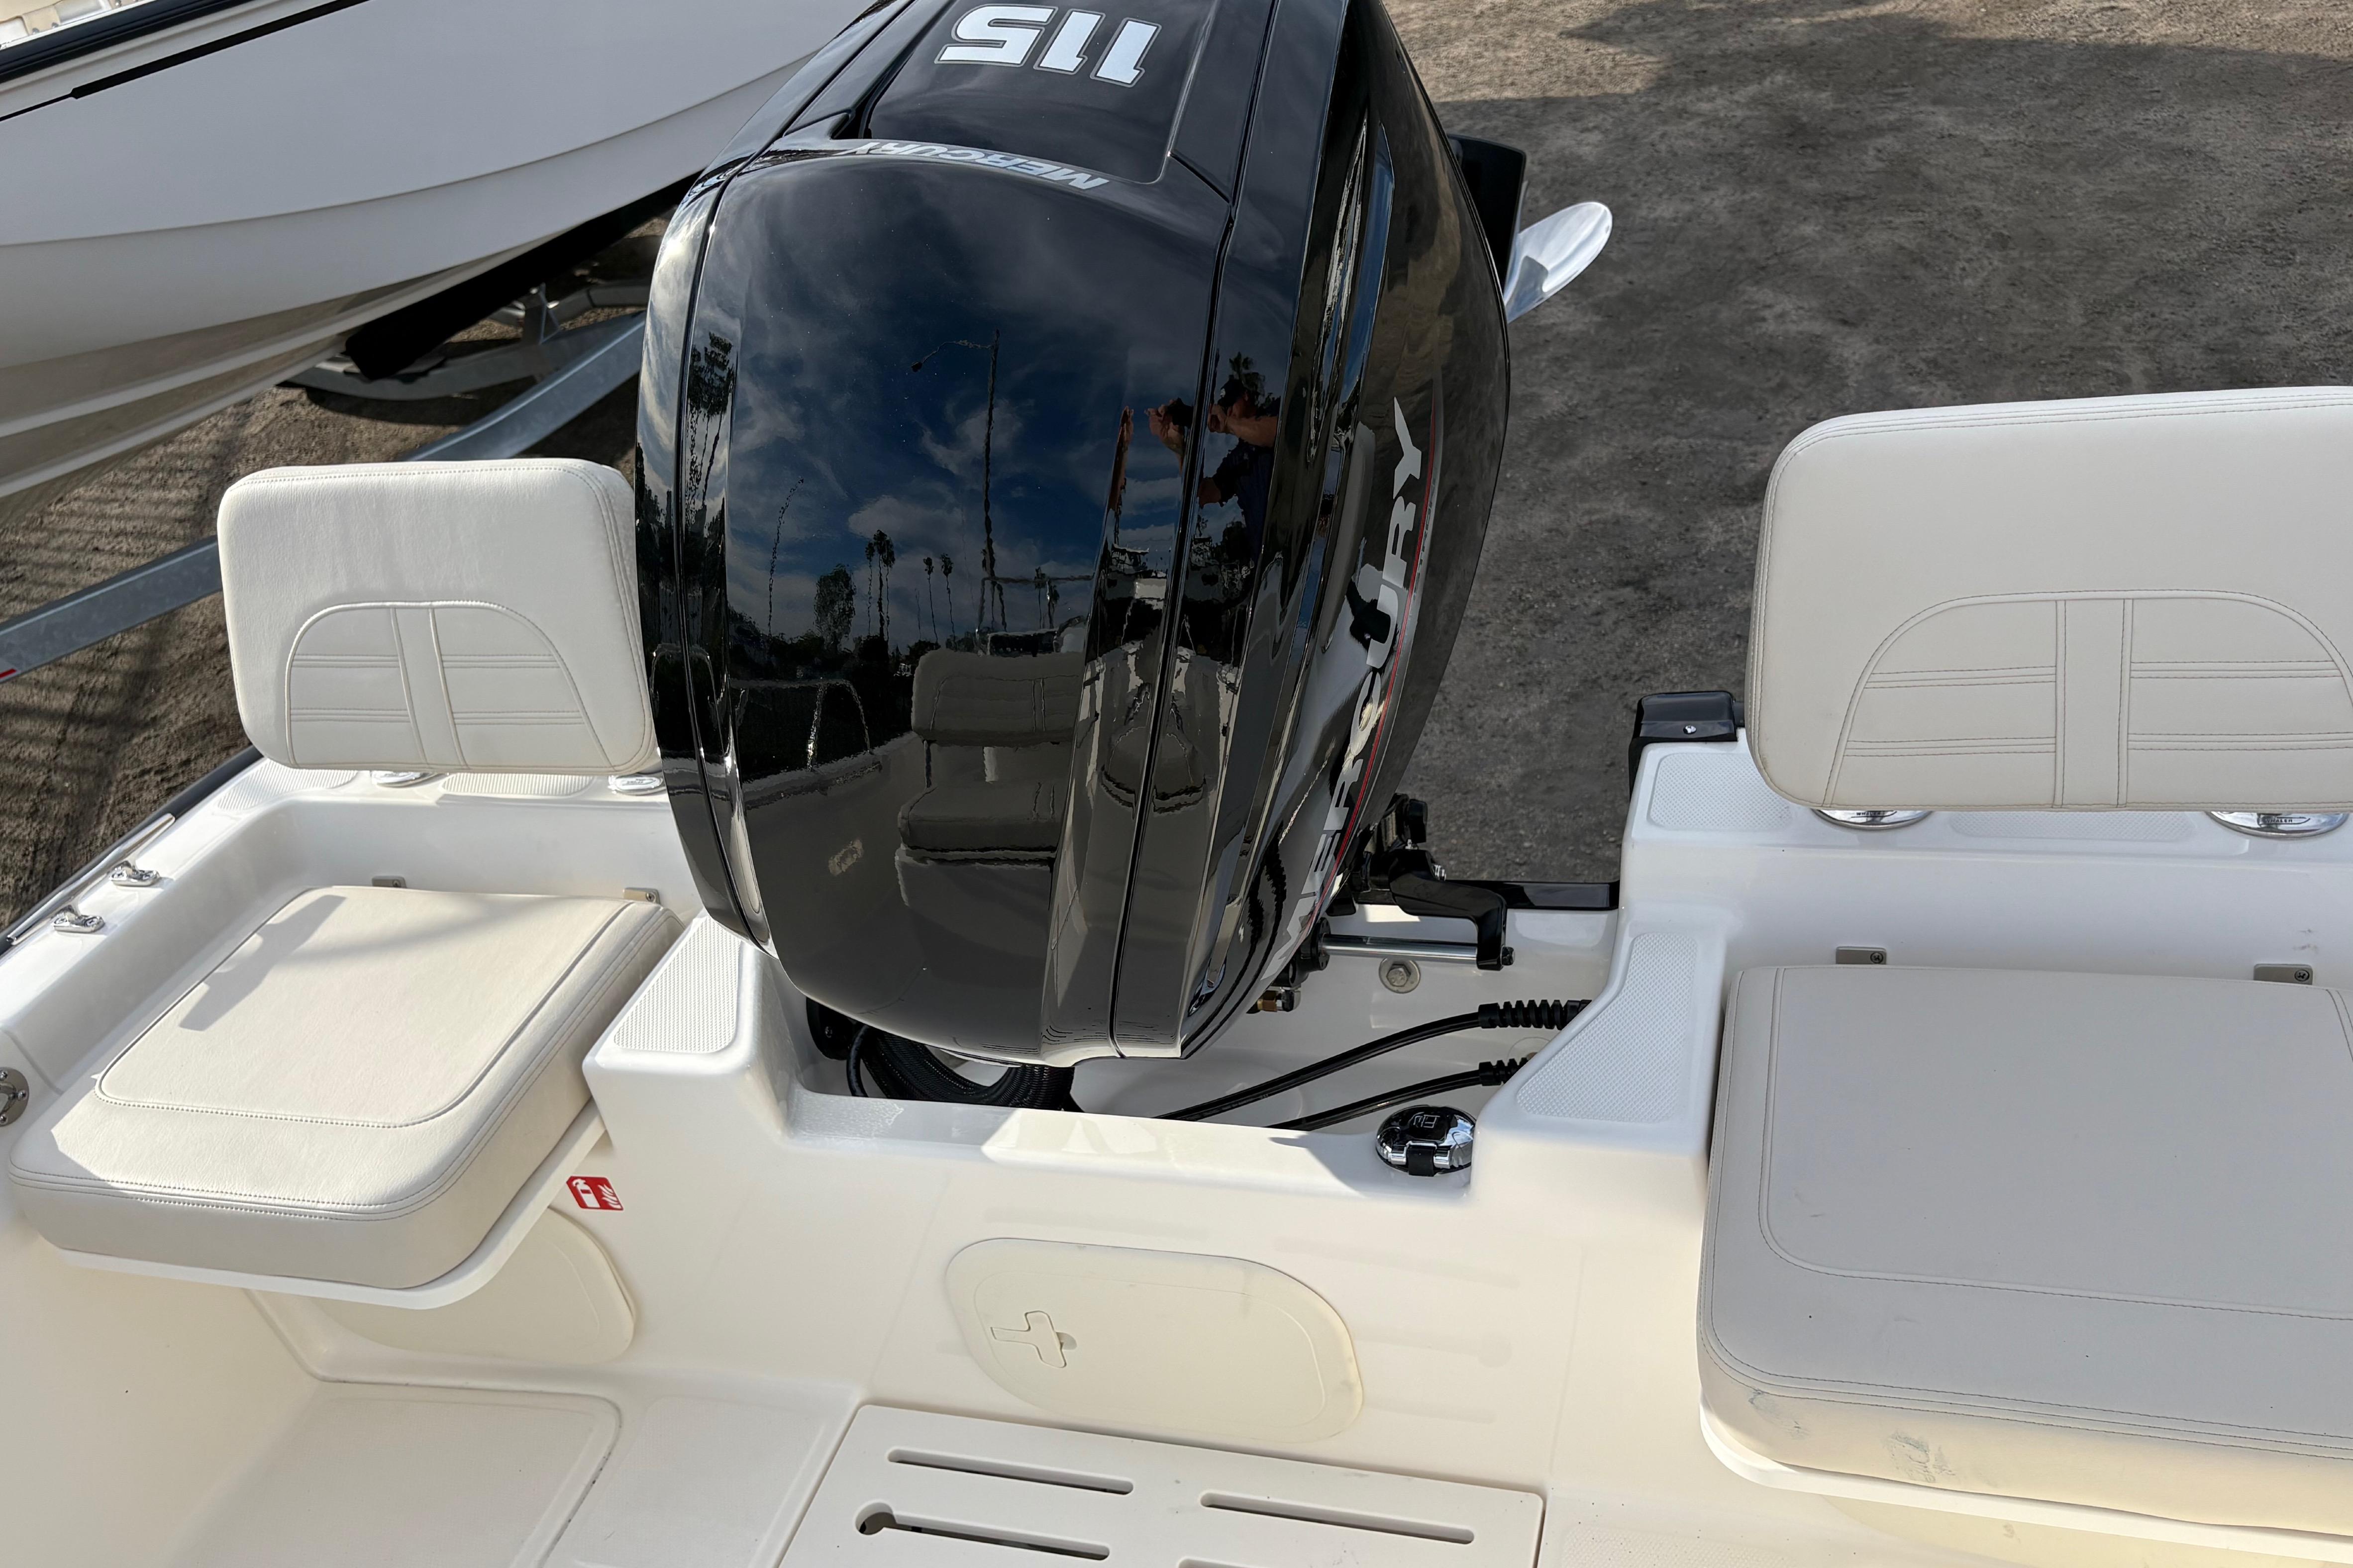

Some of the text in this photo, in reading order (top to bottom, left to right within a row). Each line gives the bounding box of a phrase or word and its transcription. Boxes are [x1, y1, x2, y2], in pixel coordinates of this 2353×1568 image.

[935, 4, 1162, 88] 115
[834, 142, 1109, 190] MERCURY
[1260, 396, 1422, 980] MERCURY
